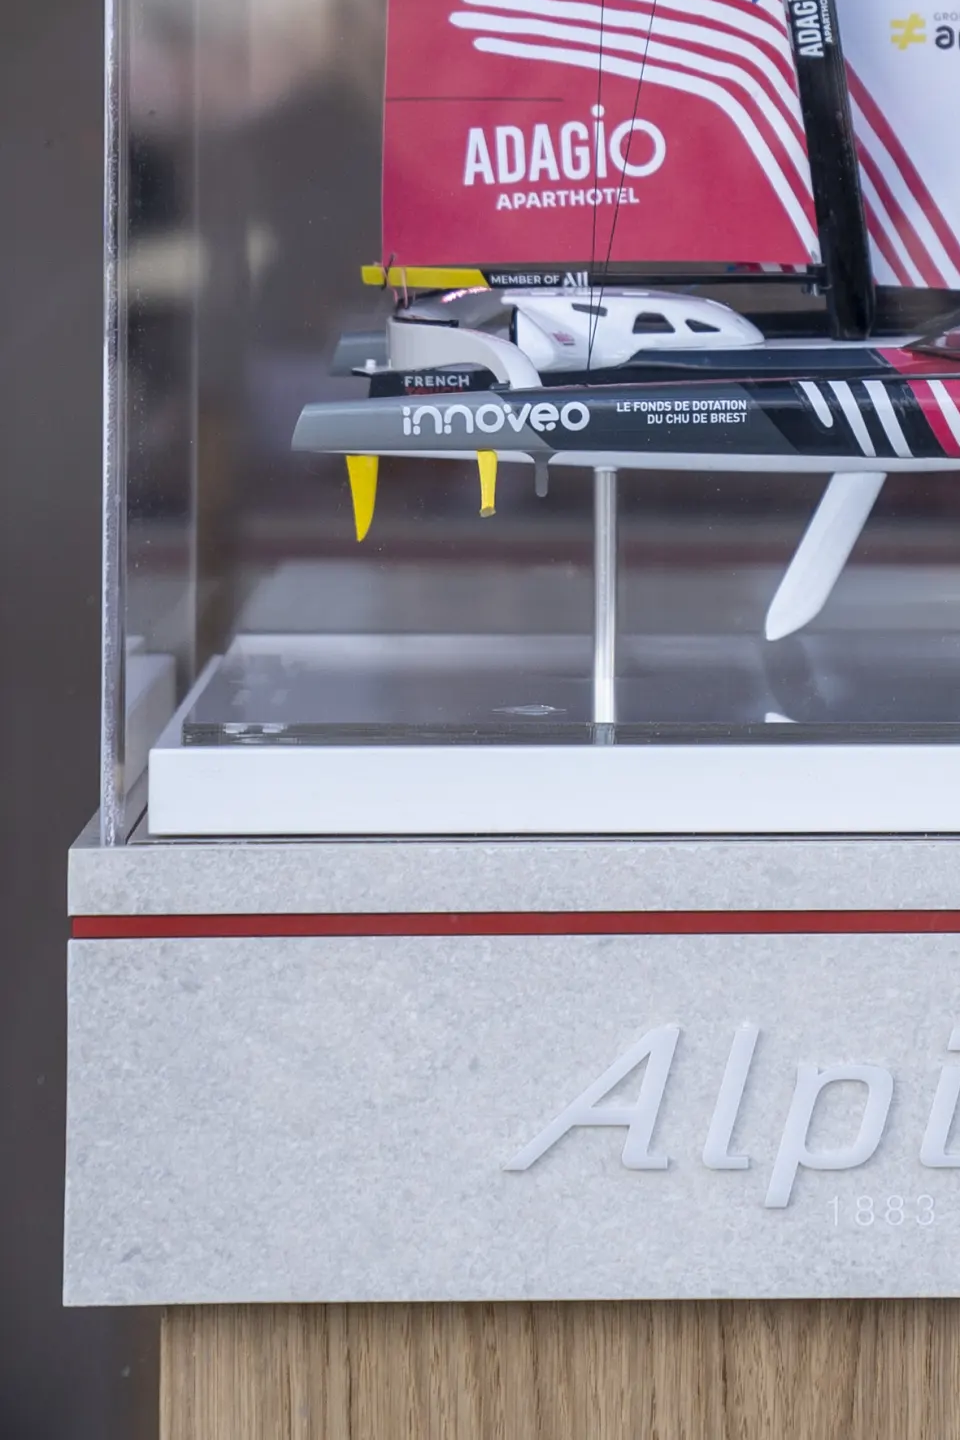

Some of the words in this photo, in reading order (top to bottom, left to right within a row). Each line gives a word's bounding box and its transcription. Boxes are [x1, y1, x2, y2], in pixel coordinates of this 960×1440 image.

[496, 187, 640, 210] APARTHOTEL
[490, 274, 540, 286] MEMBER
[544, 274, 560, 286] OF
[404, 375, 471, 388] FRENCH
[616, 402, 631, 413] LE
[634, 401, 672, 412] FONDS
[674, 401, 690, 412] DE
[692, 399, 748, 411] DOTATION
[402, 401, 591, 436] innoveo
[647, 414, 663, 425] DU
[665, 413, 690, 425] CHU
[692, 413, 708, 424] DE
[710, 412, 748, 423] BREST
[827, 1194, 937, 1227] 1883
